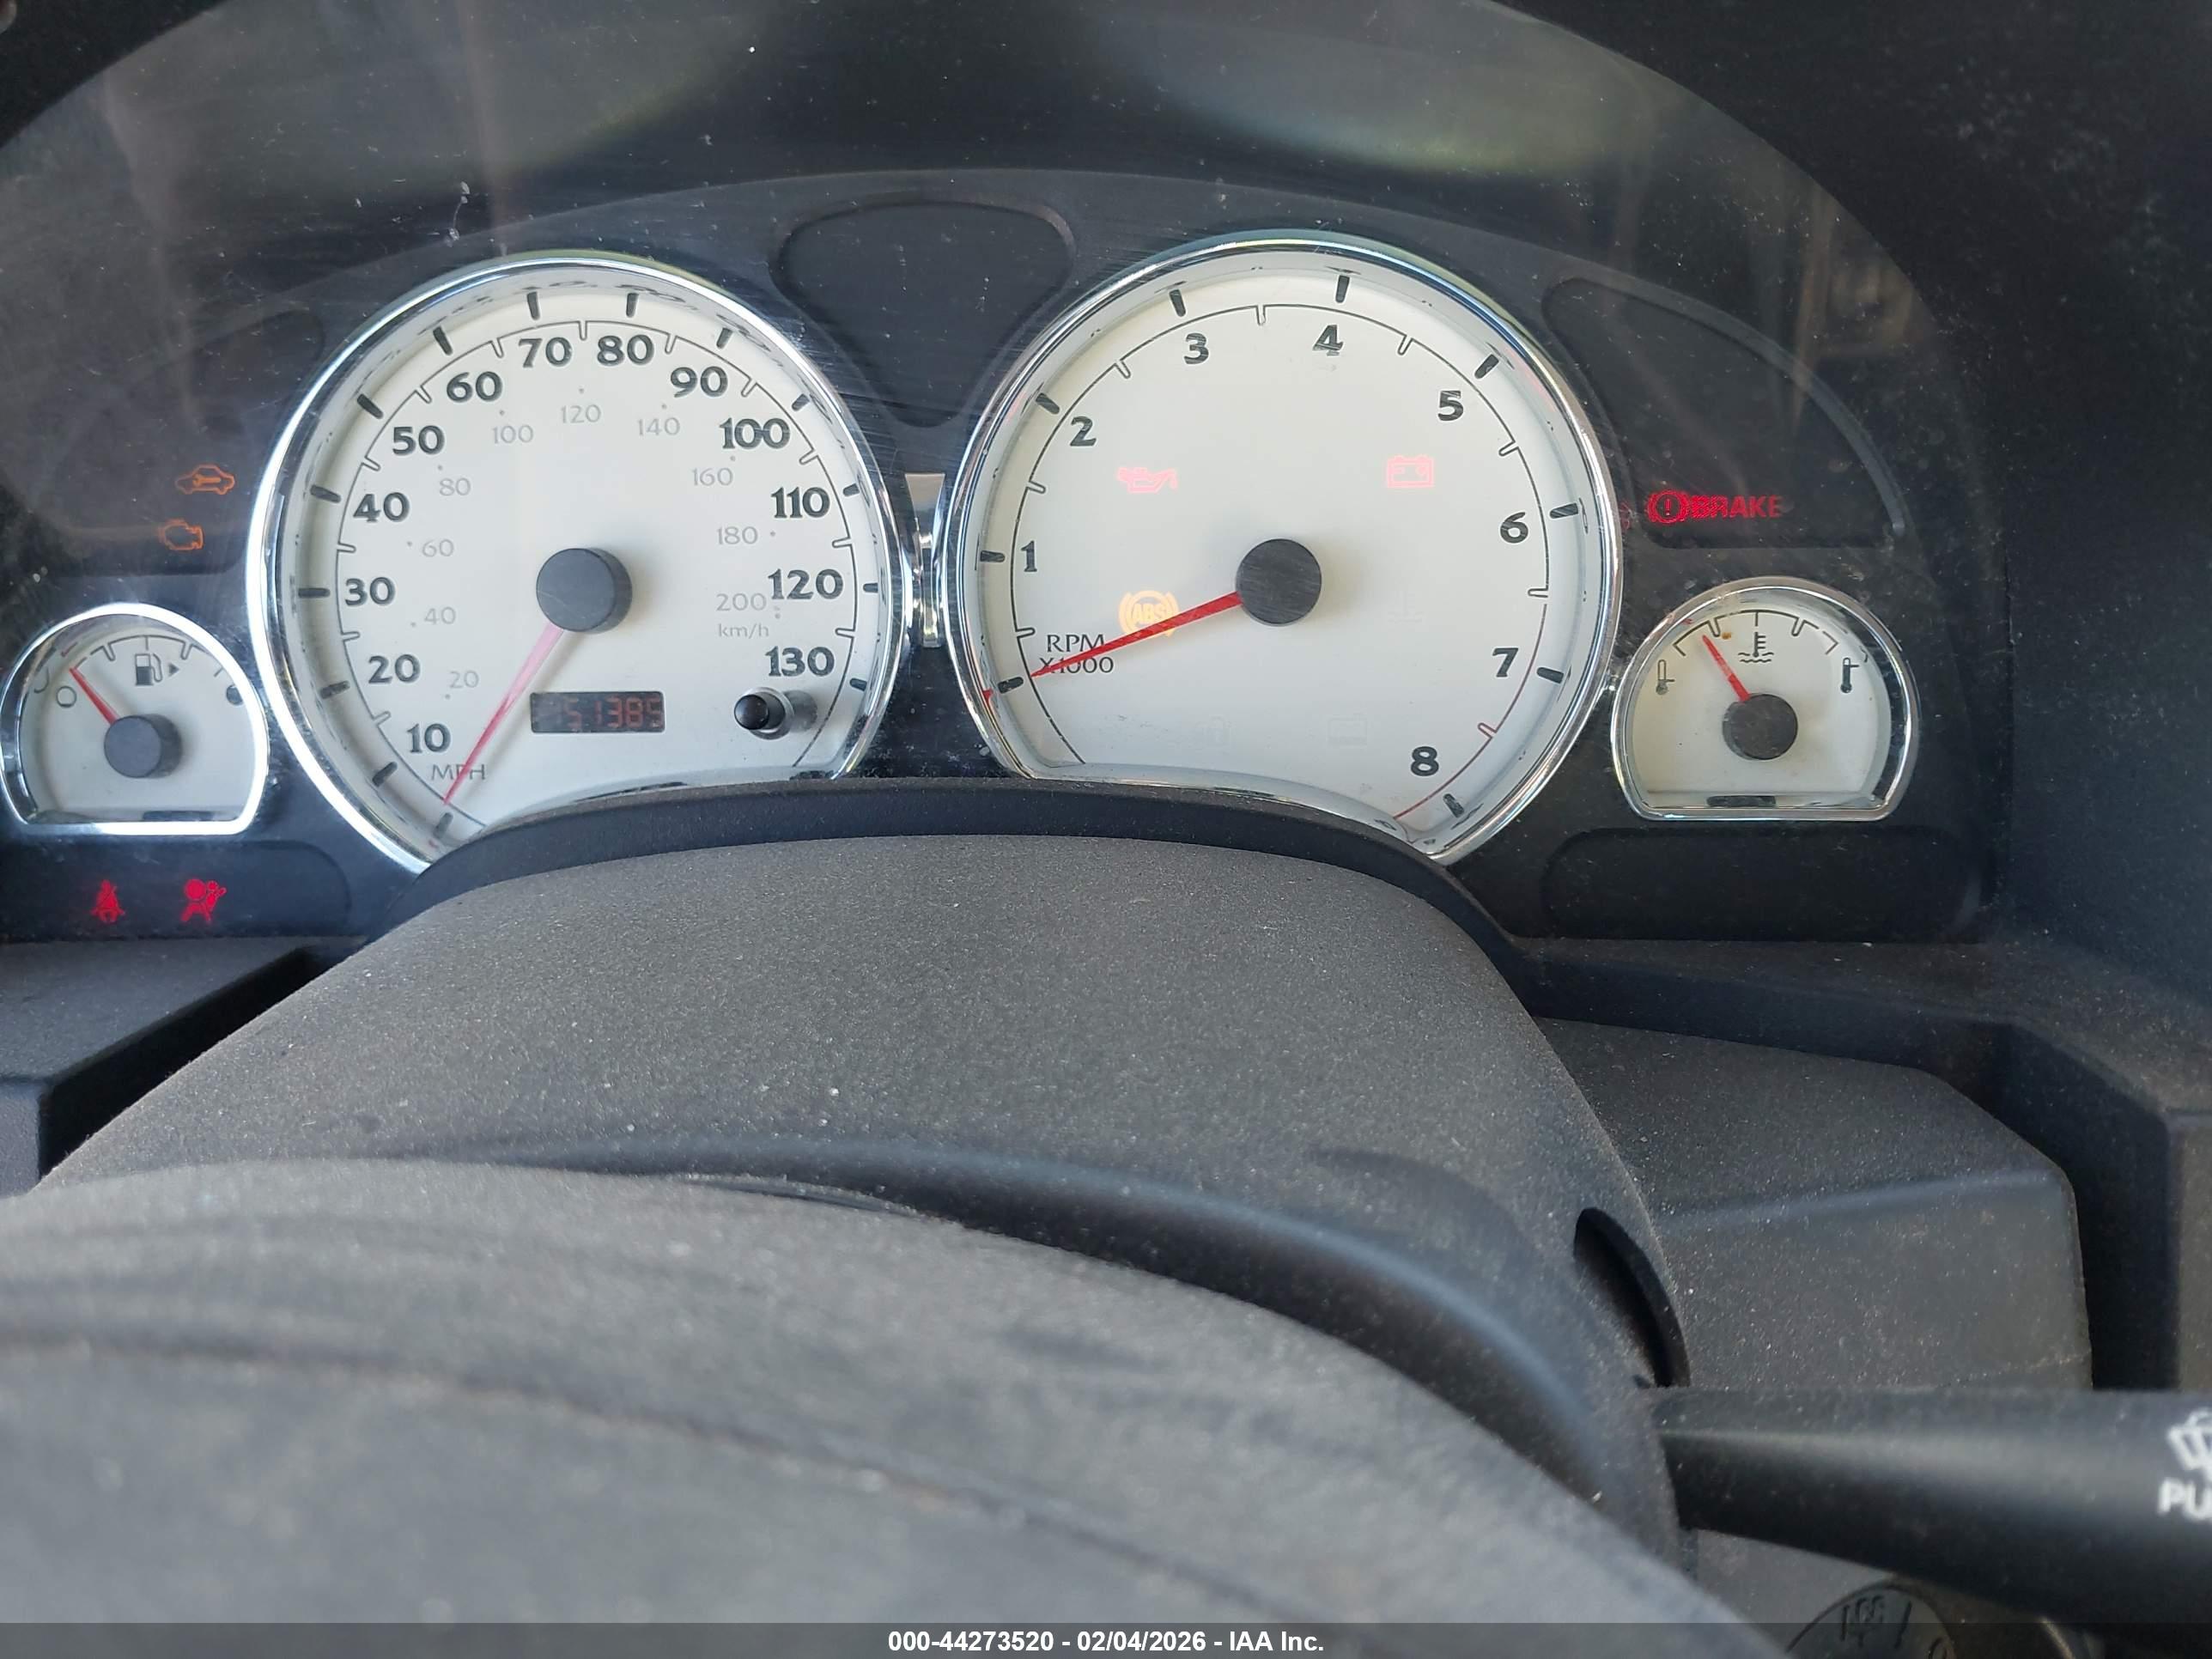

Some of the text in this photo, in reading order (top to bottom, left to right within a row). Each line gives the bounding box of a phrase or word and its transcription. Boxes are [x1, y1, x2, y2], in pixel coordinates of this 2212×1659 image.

[518, 337, 572, 368] 70
[597, 334, 654, 366] 80
[1184, 333, 1209, 364] 3
[1312, 325, 1343, 356] 4
[447, 371, 502, 403] 60
[671, 367, 728, 398] 90
[561, 404, 601, 423] 120
[1437, 390, 1464, 421] 5
[392, 426, 446, 456] 50
[493, 425, 534, 443] 100
[638, 417, 680, 435] 140
[720, 418, 791, 449] 100
[1070, 416, 1097, 447] 2
[439, 477, 471, 496] 80
[693, 468, 733, 486] 160
[353, 492, 410, 522] 40
[771, 487, 830, 518] 110
[1691, 495, 1782, 518] BRAKE
[717, 526, 758, 544] 180
[1500, 512, 1528, 544] 6
[422, 539, 454, 557] 60
[1020, 540, 1037, 573] 1
[345, 577, 396, 605] 30
[768, 568, 844, 600] 120
[424, 606, 456, 624] 40
[716, 592, 767, 611] 200
[1132, 603, 1168, 623] ABS
[718, 623, 769, 639] km/h
[1047, 634, 1105, 653] RPM
[368, 654, 421, 684] 20
[765, 647, 835, 677] 130
[1492, 647, 1518, 678] 7
[449, 671, 479, 688] 20
[406, 723, 451, 753] 10
[1410, 746, 1439, 777] 8
